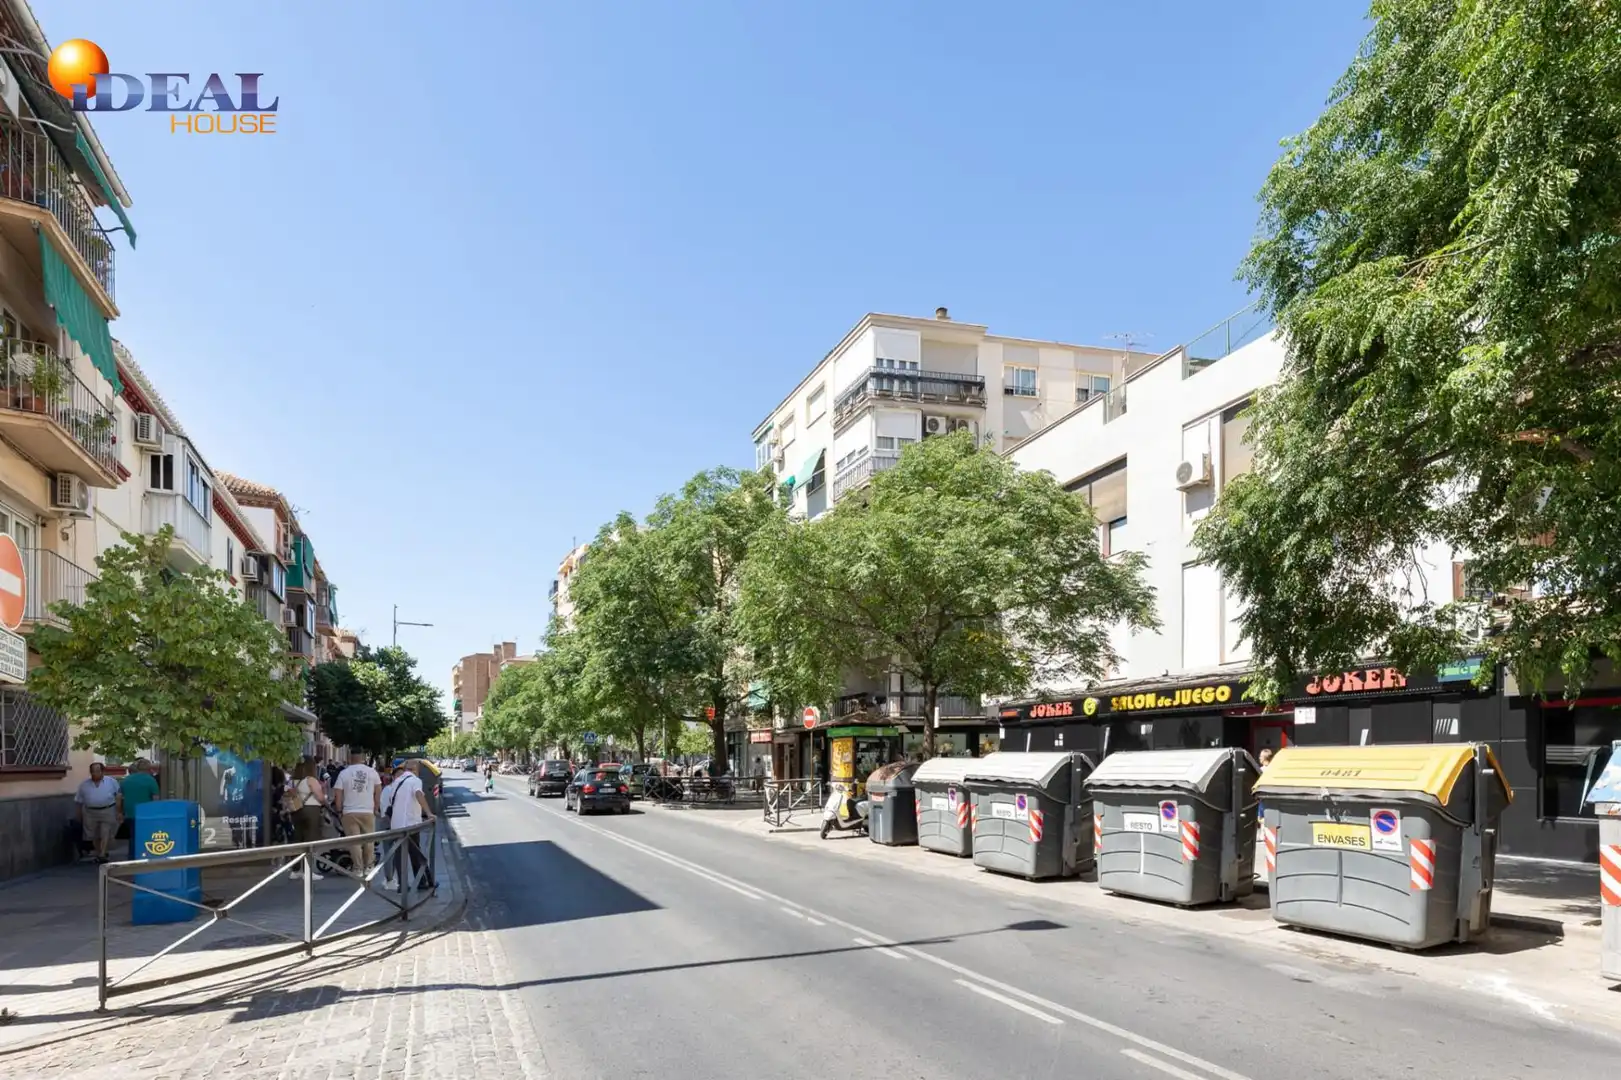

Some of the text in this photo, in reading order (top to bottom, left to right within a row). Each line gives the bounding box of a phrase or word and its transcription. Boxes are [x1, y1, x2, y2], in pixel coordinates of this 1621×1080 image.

[1306, 667, 1406, 694] JOKER
[1110, 685, 1232, 712] SALON de JUEGO
[1029, 701, 1074, 718] JOKER
[222, 815, 258, 825] Respira
[1130, 822, 1153, 831] RESTO
[1317, 834, 1366, 847] ENVASES
